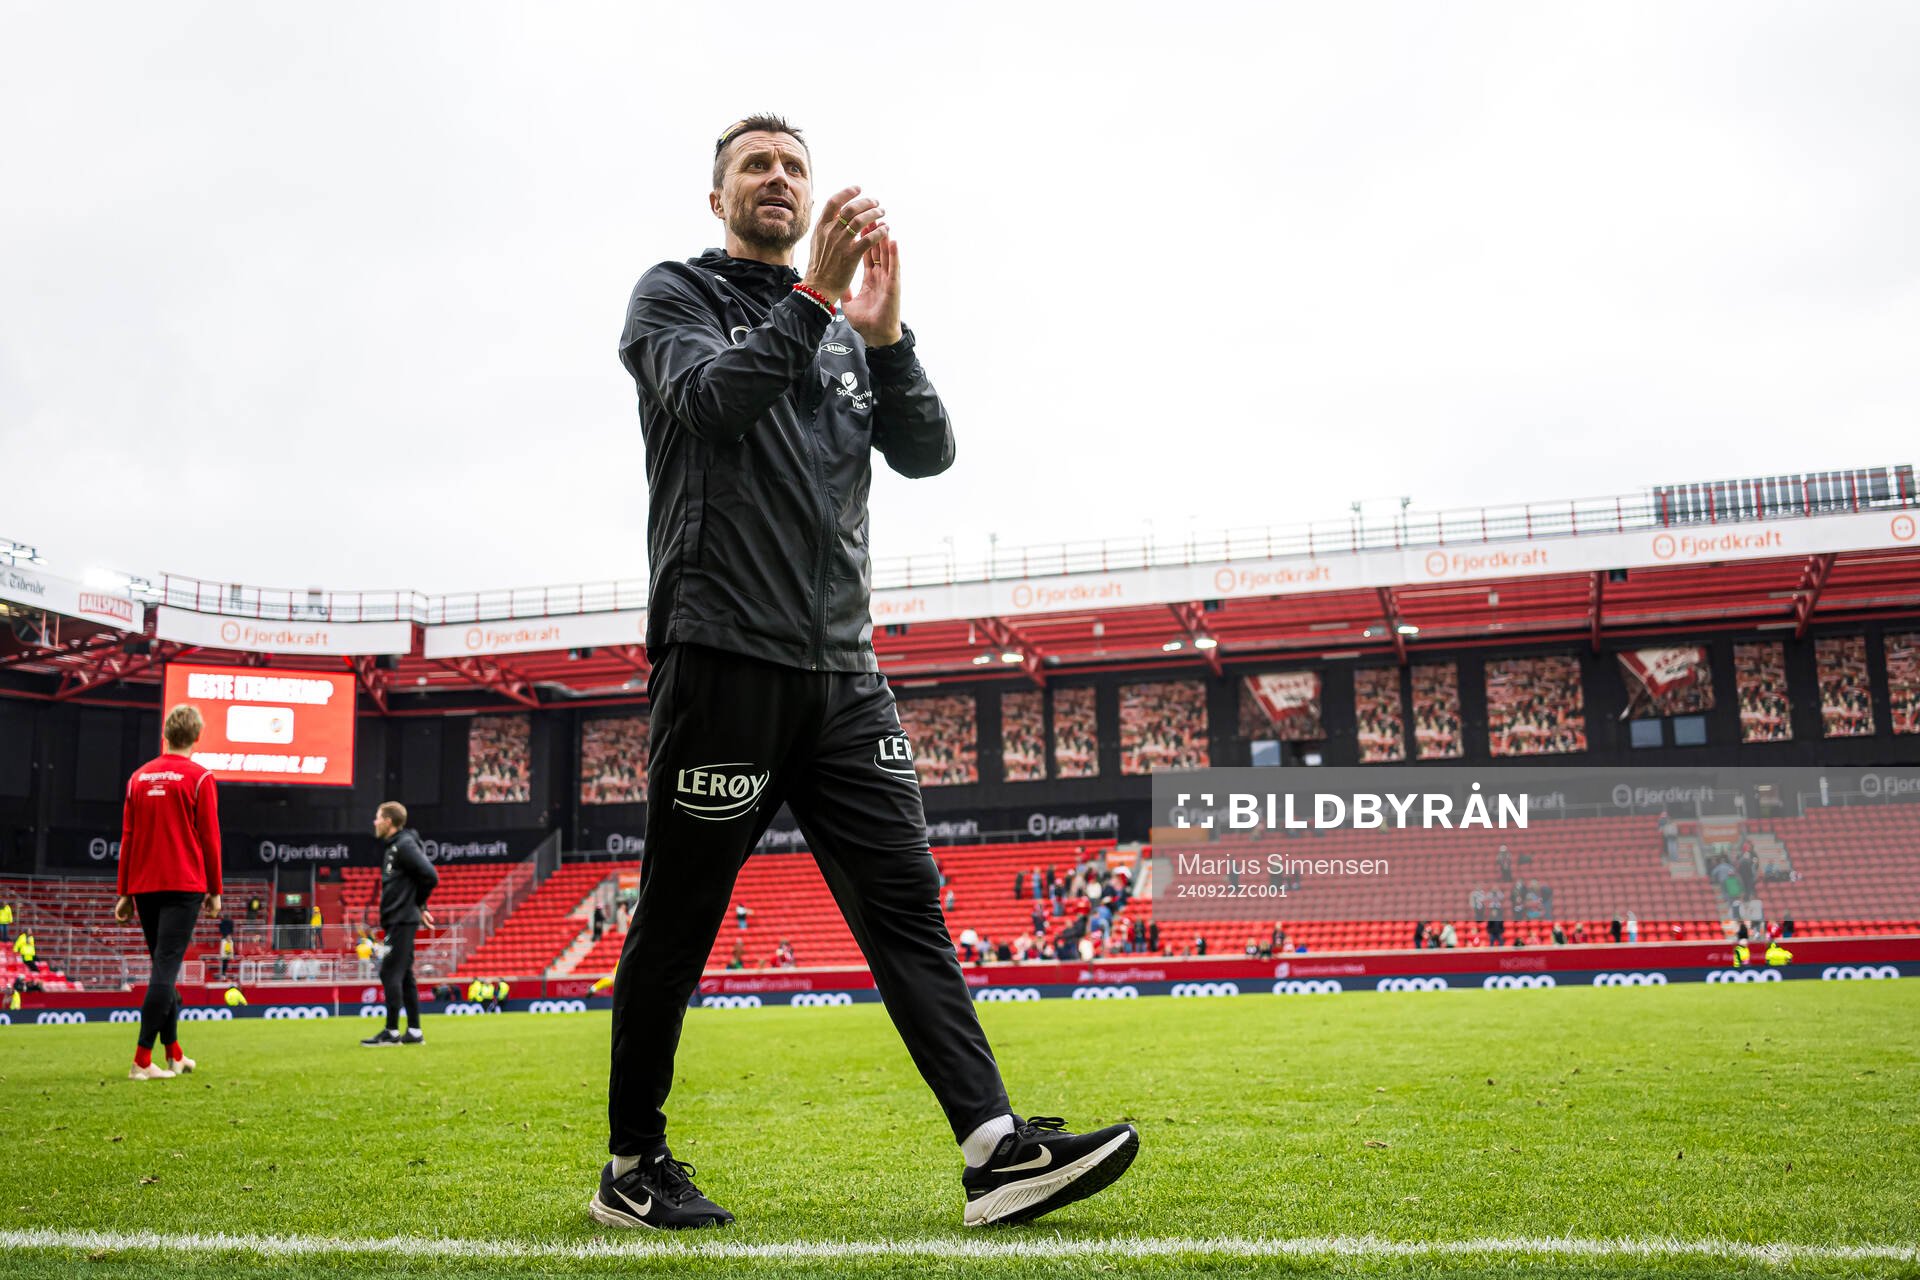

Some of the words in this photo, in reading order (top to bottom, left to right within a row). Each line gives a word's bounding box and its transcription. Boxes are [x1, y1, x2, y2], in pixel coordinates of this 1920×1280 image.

[1681, 530, 1784, 556] Fjordkraft
[1452, 549, 1548, 573] Fjordkraft
[1239, 565, 1331, 588] Fjordkraft
[1036, 583, 1122, 602] Fjordkraft
[243, 629, 329, 648] Fjordkraft
[486, 626, 561, 646] Fjordkraft
[677, 768, 766, 798] LERØY
[1634, 786, 1714, 808] Fjordkraft
[1047, 813, 1119, 834] Fjordkraft
[276, 843, 349, 862] Fjordkraft
[440, 840, 508, 861] Fjordkraft
